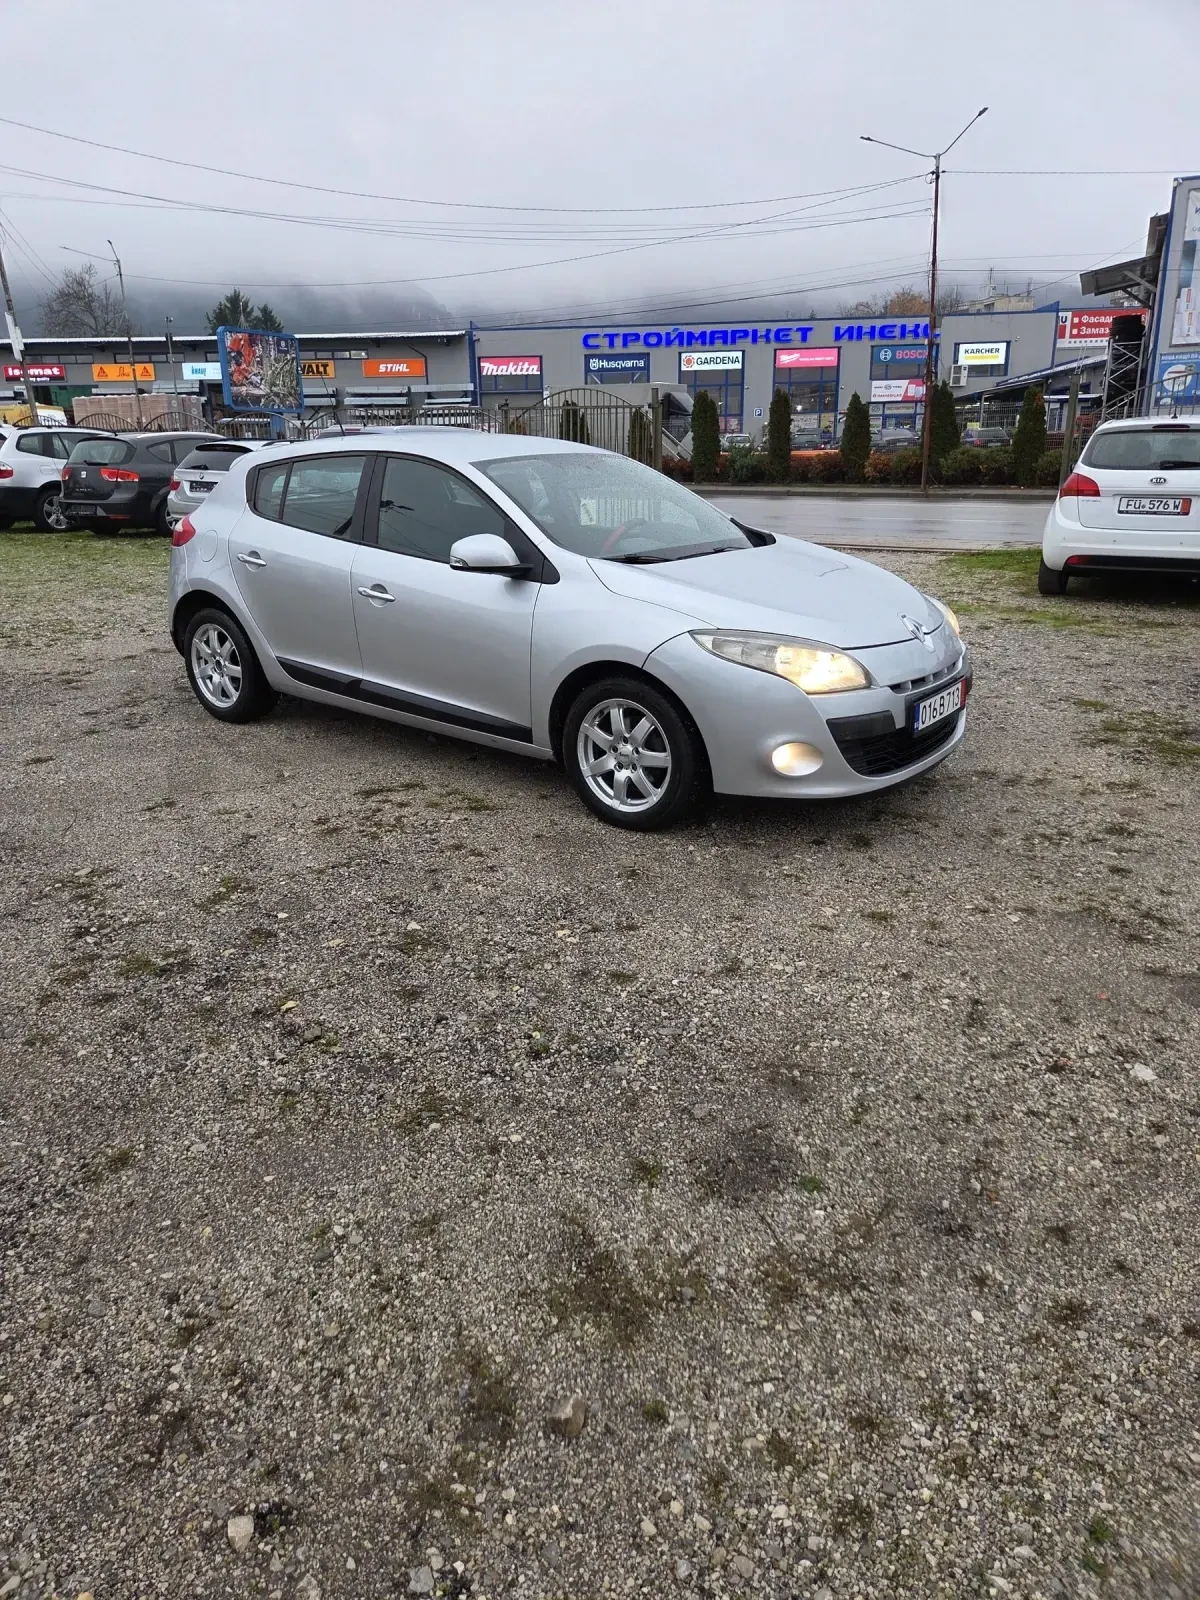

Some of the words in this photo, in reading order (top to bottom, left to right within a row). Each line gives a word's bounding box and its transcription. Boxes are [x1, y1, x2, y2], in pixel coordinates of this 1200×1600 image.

[582, 328, 813, 349] СТРОЙМАРКЕТ
[895, 350, 929, 359] BOSCH
[599, 359, 645, 370] Husqvarna
[696, 356, 740, 366] GARDENA
[378, 363, 410, 373] STIHL
[1125, 499, 1143, 510] FÜ
[1148, 500, 1170, 511] 576
[1172, 501, 1181, 511] W
